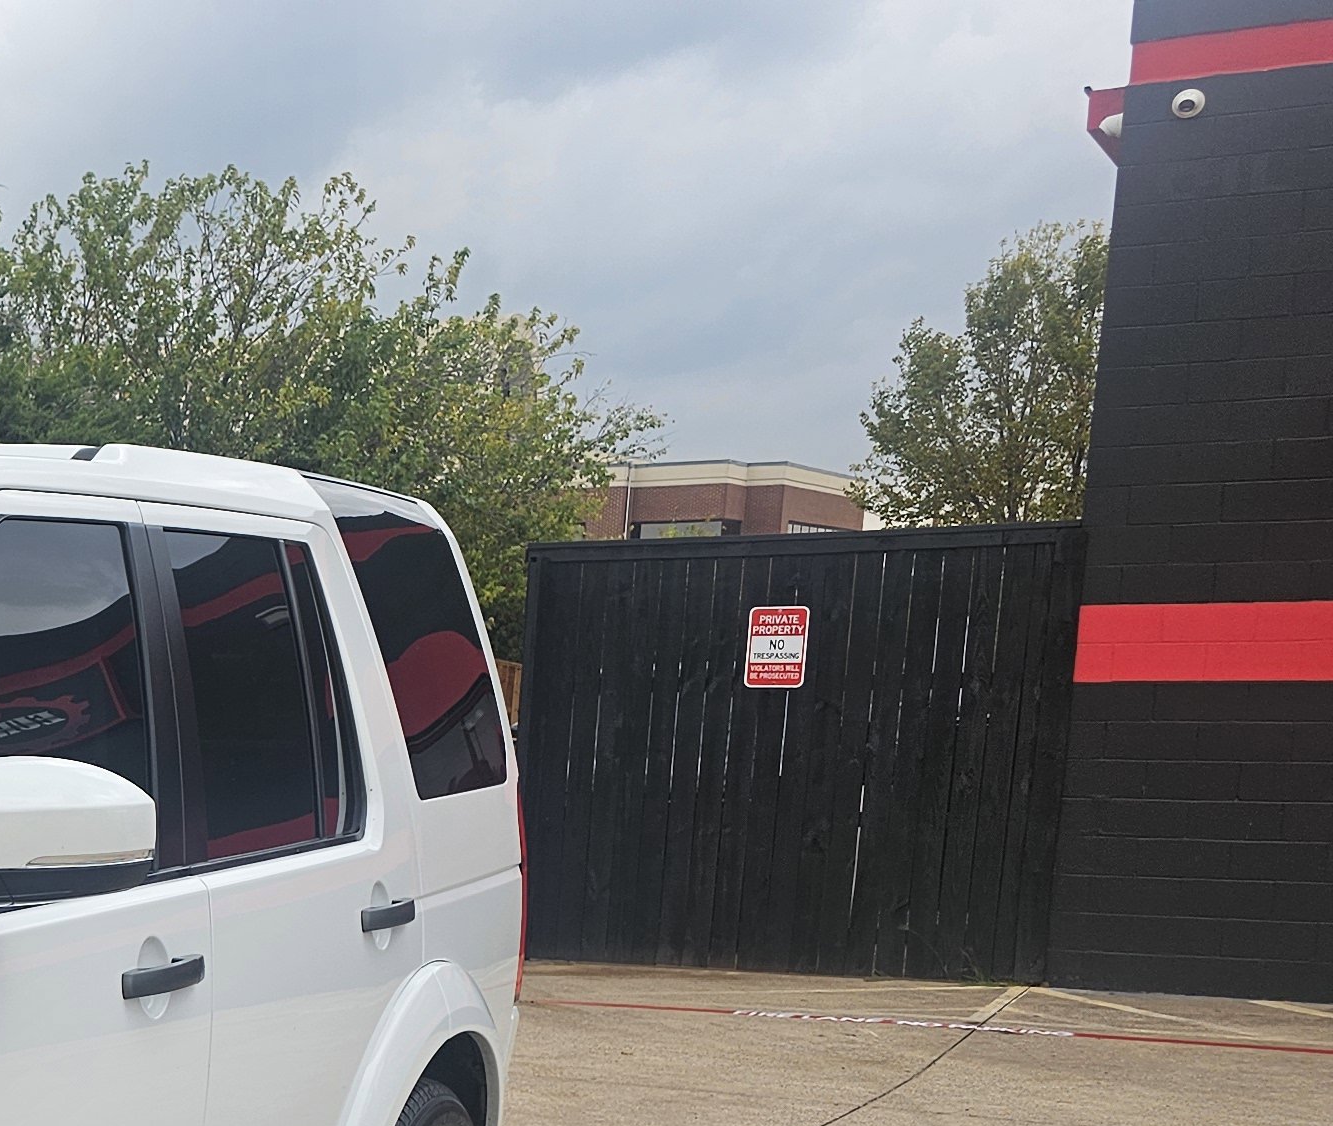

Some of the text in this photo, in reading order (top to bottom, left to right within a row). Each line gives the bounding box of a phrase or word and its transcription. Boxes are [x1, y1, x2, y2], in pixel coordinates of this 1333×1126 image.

[759, 614, 800, 625] PRIVATE
[752, 625, 805, 635] PROPERTY
[769, 639, 785, 651] NO
[753, 652, 800, 660] TRESPASSING
[750, 664, 800, 672] VIOLATORS WILL
[749, 672, 800, 680] BE PROSECUTED
